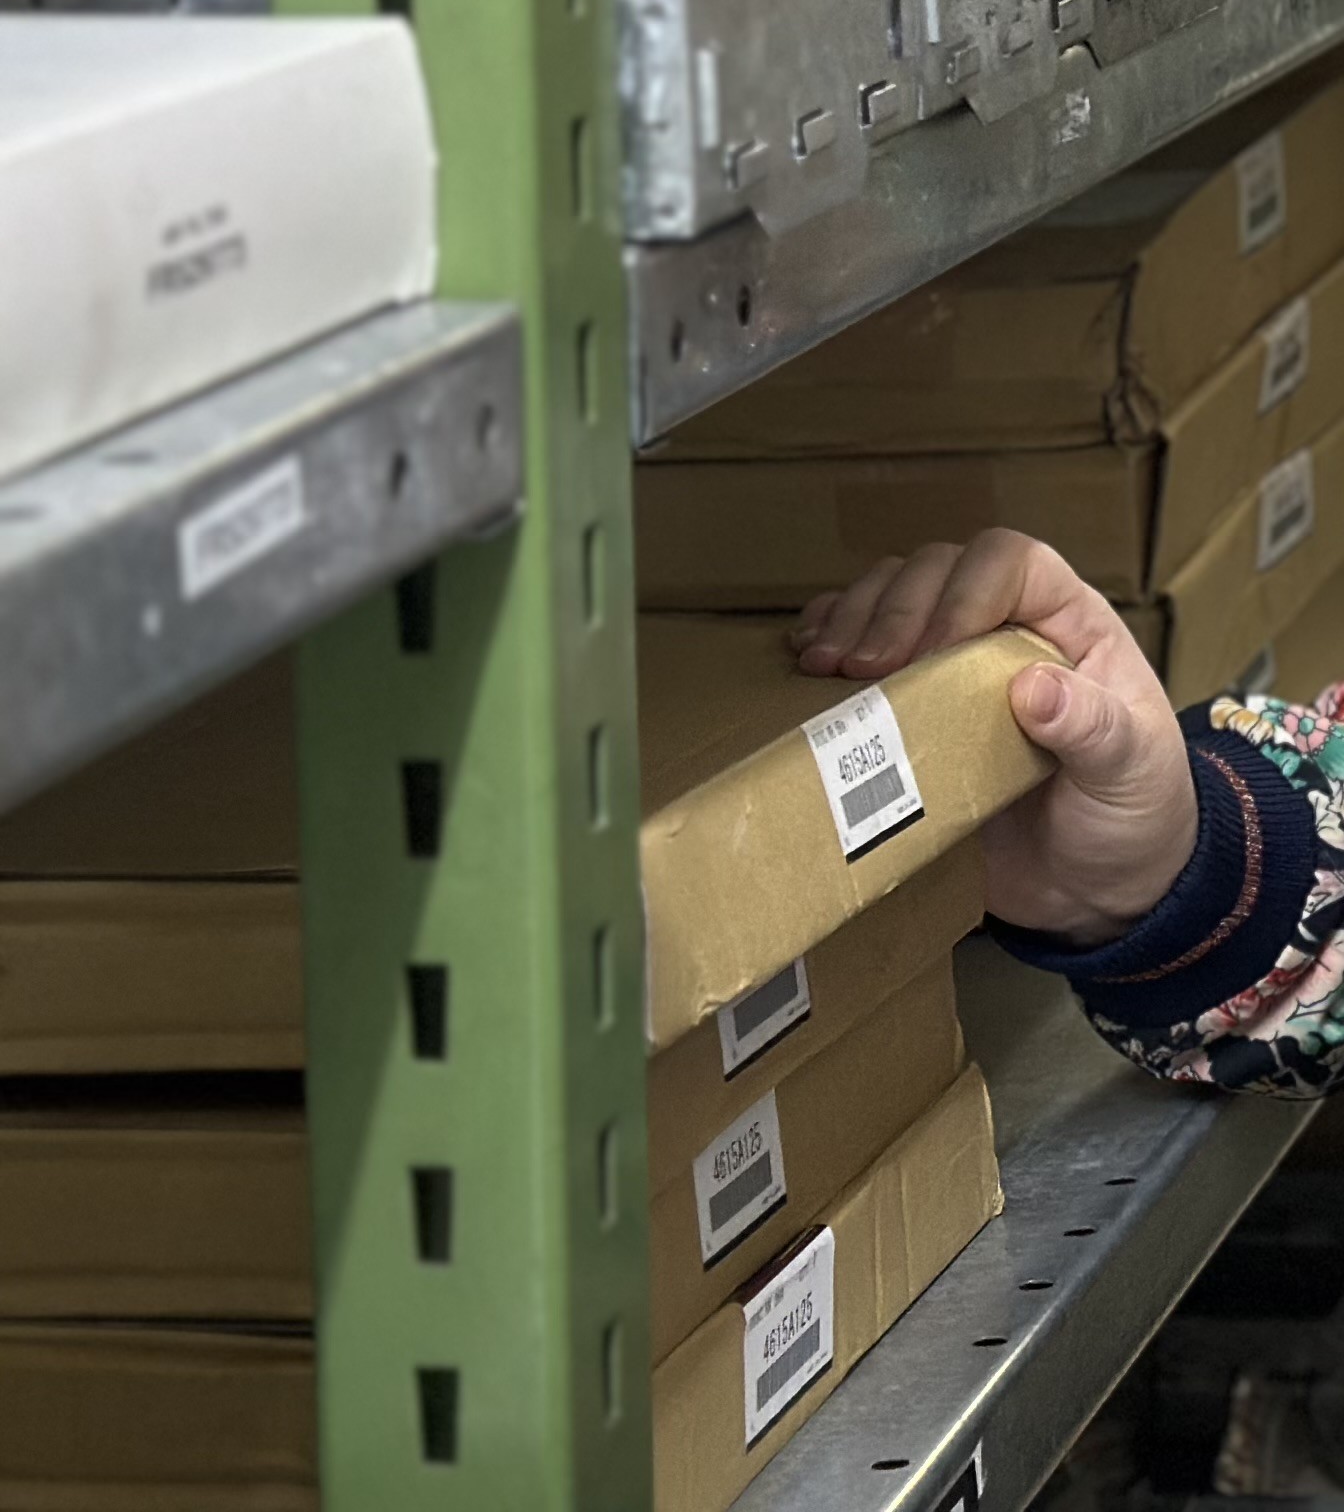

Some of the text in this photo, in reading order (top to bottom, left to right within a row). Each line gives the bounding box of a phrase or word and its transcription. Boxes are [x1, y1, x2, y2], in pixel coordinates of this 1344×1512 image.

[837, 733, 887, 785] 4615A125
[712, 1121, 762, 1182] 4615A125
[763, 1290, 814, 1364] 4615A125
